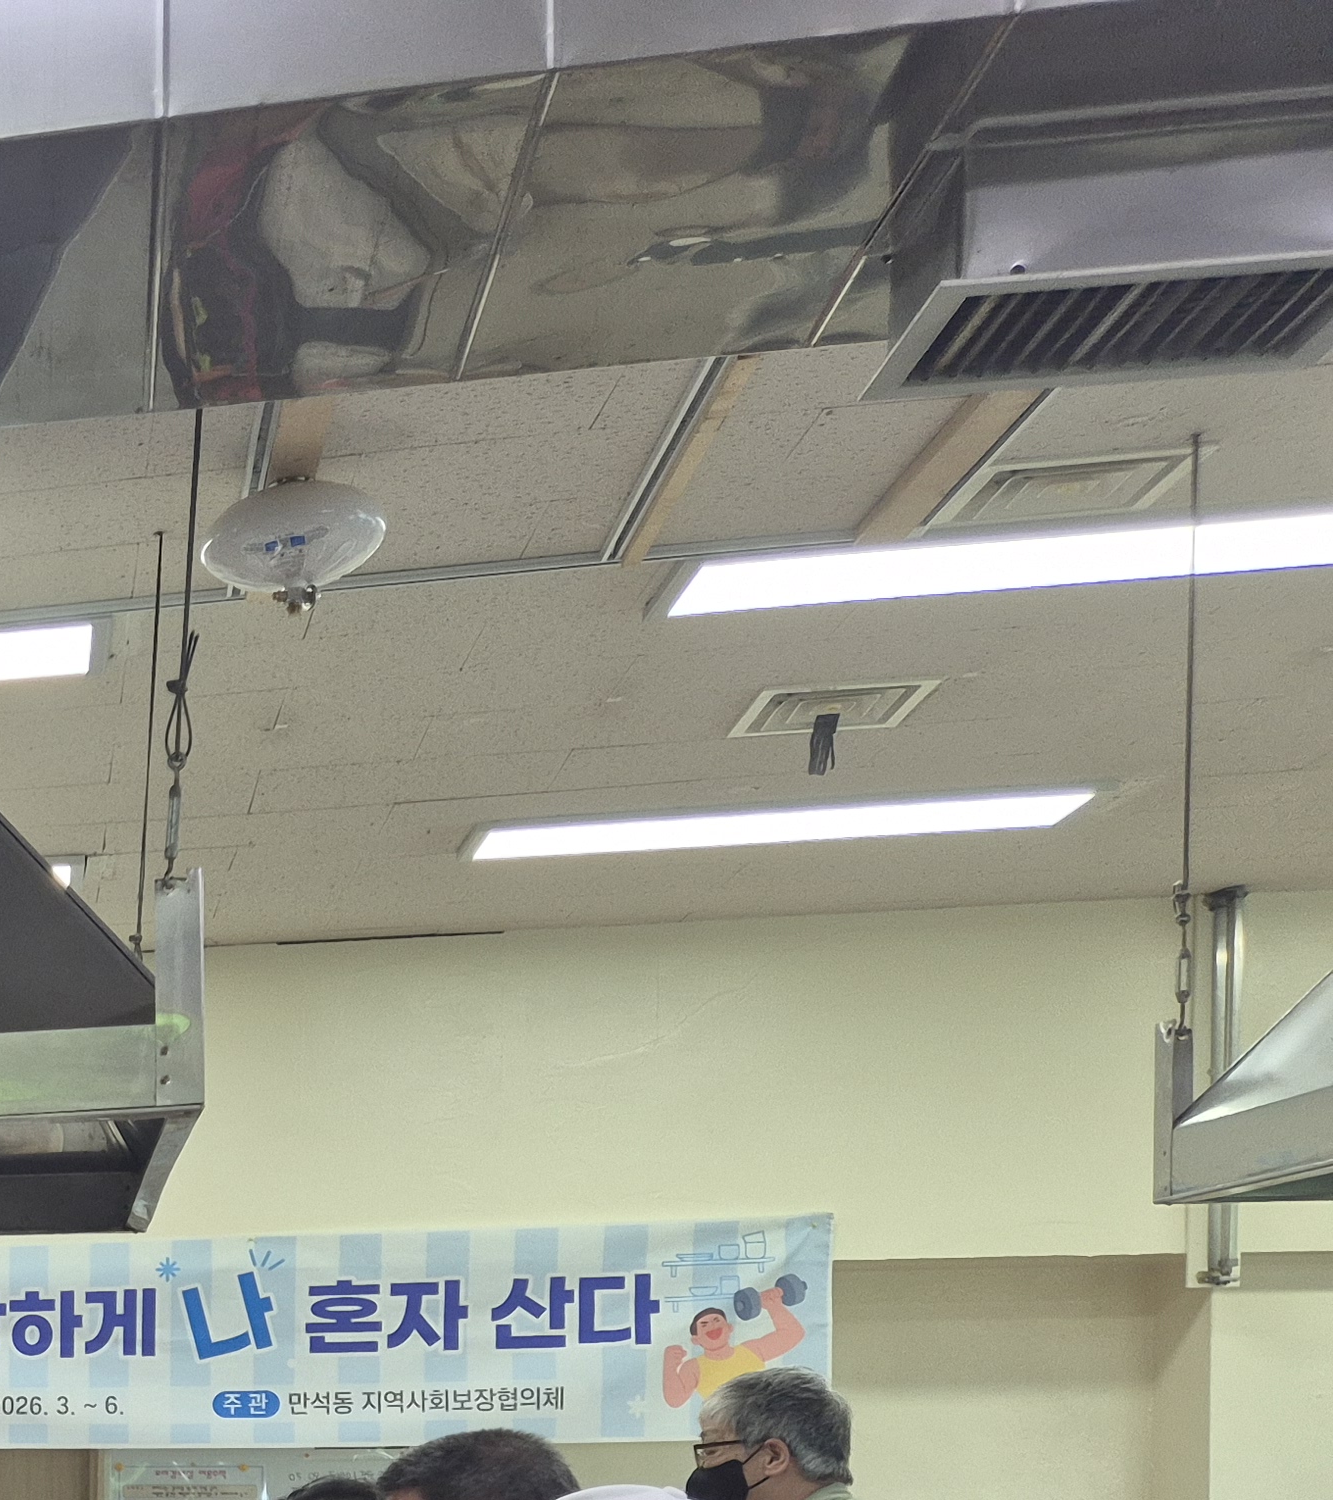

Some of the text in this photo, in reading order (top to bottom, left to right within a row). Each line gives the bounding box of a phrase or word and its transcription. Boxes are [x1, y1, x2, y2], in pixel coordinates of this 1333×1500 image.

[181, 1271, 274, 1361] 나
[305, 1279, 469, 1354] 혼자
[490, 1273, 661, 1350] 산다
[56, 1396, 76, 1416] 3.
[105, 1396, 125, 1416] 6.
[288, 1390, 354, 1416] 만석동
[361, 1386, 565, 1414] 지역사회보장협의체
